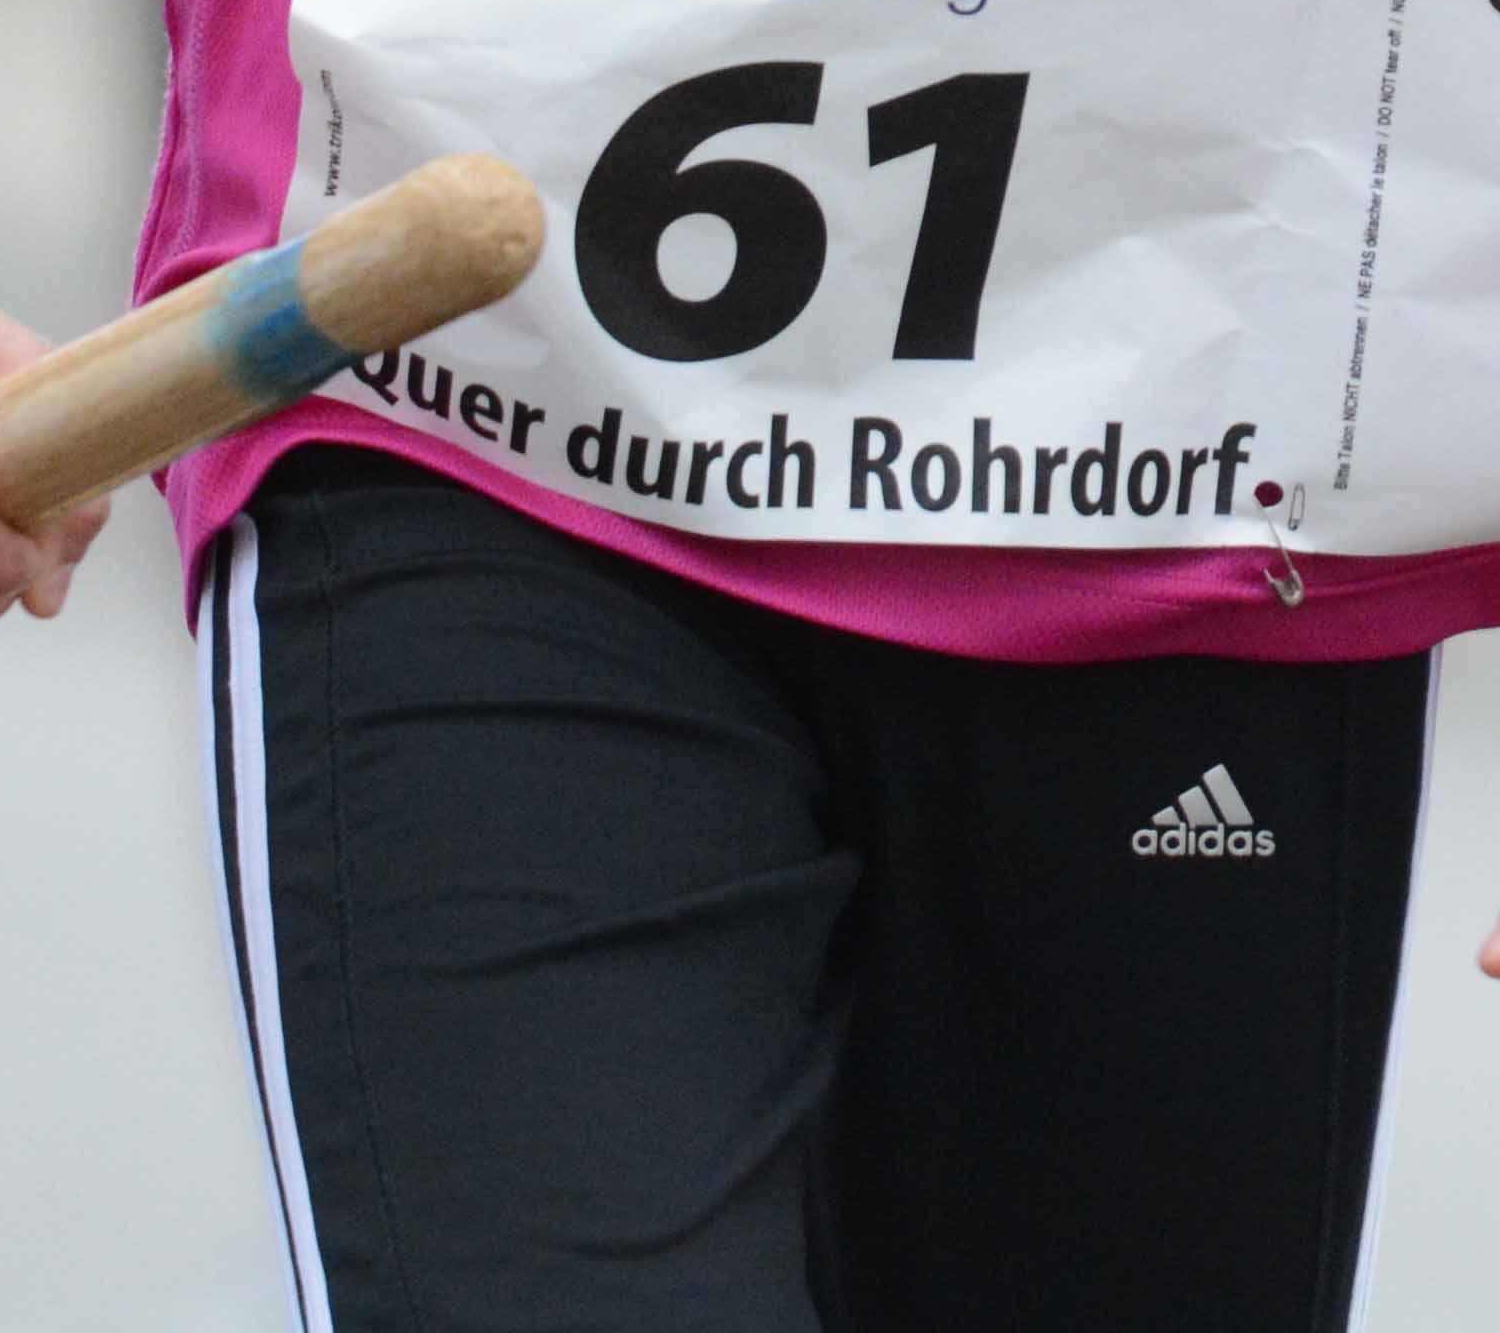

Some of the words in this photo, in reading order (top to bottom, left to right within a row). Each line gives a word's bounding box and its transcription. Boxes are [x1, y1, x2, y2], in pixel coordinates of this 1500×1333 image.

[1386, 29, 1402, 49] off
[1383, 50, 1399, 75] tear
[1379, 76, 1397, 105] NOT
[1376, 107, 1393, 128] DO
[1371, 144, 1389, 176] talon
[575, 61, 1030, 362] 61
[1363, 193, 1383, 249] détacher
[1359, 251, 1377, 279] PAS
[1358, 281, 1373, 301] NE
[1348, 317, 1368, 381] abtrennen
[1342, 382, 1359, 423] NICHT
[1338, 426, 1355, 460] Talon
[566, 407, 815, 509] durch
[850, 416, 1257, 517] Rohrdorf
[1132, 822, 1276, 856] adidas
